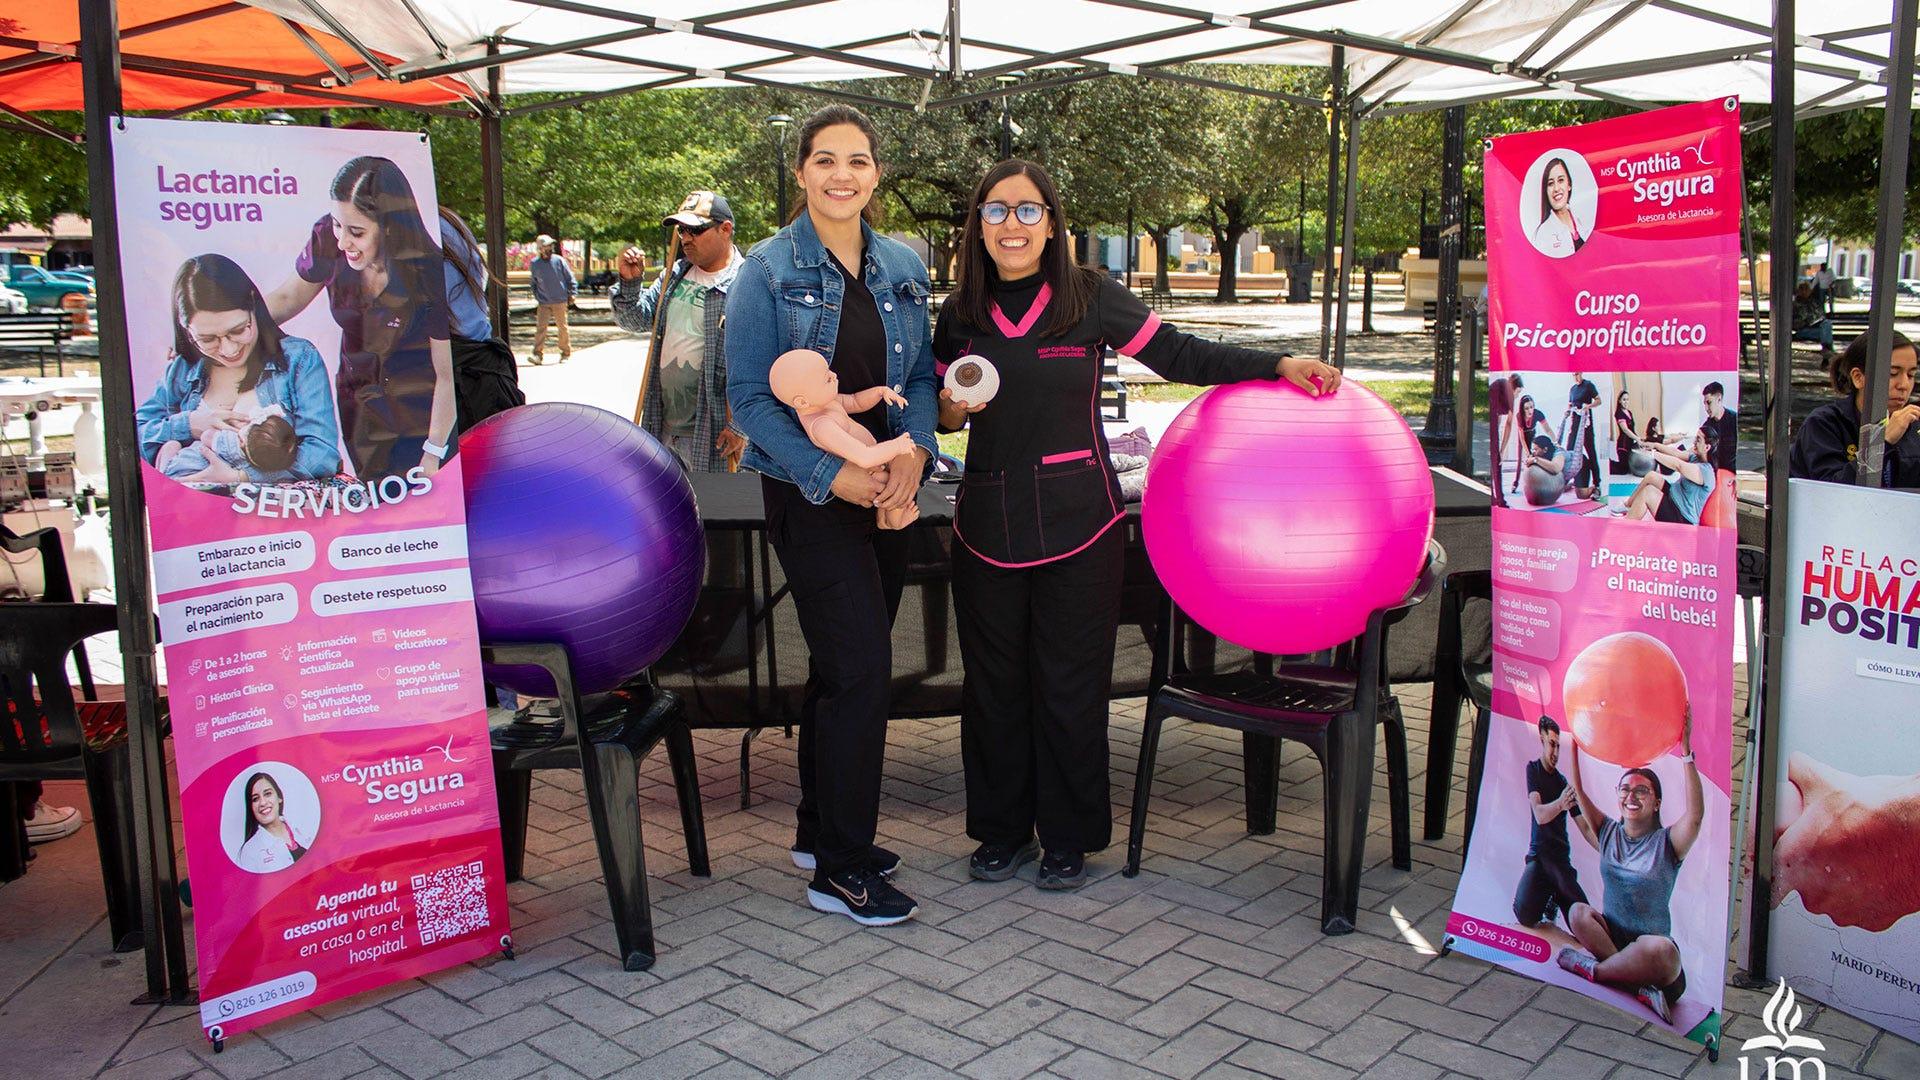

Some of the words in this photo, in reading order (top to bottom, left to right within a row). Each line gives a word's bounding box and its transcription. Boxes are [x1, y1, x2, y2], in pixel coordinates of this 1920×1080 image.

[1600, 167, 1615, 177] MSP
[1616, 151, 1682, 182] Cynthia
[157, 165, 298, 195] Lactancia
[1633, 174, 1714, 207] Segura
[160, 200, 263, 230] segura
[1637, 212, 1666, 223] Asesora
[1667, 211, 1677, 220] de
[1678, 206, 1714, 219] Lactancia
[1575, 290, 1640, 316] Curso
[1503, 318, 1707, 355] Psicoprofiláctico
[231, 465, 433, 519] SERVICIOS
[198, 546, 256, 562] Embarazo
[258, 545, 267, 553] e
[269, 539, 302, 552] inicio
[341, 546, 382, 558] Banco
[384, 543, 401, 554] de
[403, 540, 439, 552] leche
[1537, 548, 1568, 561] pareja
[1822, 545, 1918, 576] RELAC
[201, 567, 215, 578] de
[216, 564, 227, 575] la
[228, 557, 286, 573] lactancia
[1590, 548, 1678, 573] ¡Prepárate
[1681, 561, 1718, 579] para
[323, 591, 374, 605] Destete
[376, 584, 447, 599] respetuoso
[1607, 572, 1623, 591] el
[1627, 578, 1718, 603] nacimiento
[185, 596, 253, 617] Preparación
[255, 592, 285, 606] para
[1522, 602, 1547, 615] rebozo
[1642, 600, 1666, 619] del
[1670, 603, 1717, 628] bebé!
[186, 621, 198, 633] el
[200, 610, 264, 630] nacimiento
[1800, 594, 1920, 649] POSIT
[297, 635, 357, 651] Información
[394, 637, 448, 650] educativos
[204, 659, 218, 669] De
[219, 657, 225, 666] 1
[233, 653, 240, 663] 2
[240, 650, 268, 661] horas
[300, 659, 354, 675] actualizada
[394, 664, 426, 674] Grupo
[427, 661, 441, 670] de
[1867, 662, 1893, 674] CÓMO
[207, 671, 218, 682] de
[396, 675, 427, 687] apoyo
[429, 669, 461, 681] virtual
[301, 683, 364, 699] Seguimiento
[319, 694, 372, 708] WhatsApp
[397, 688, 420, 699] para
[421, 682, 459, 694] madres
[211, 706, 266, 726] Planificación
[303, 711, 330, 722] hasta
[331, 709, 341, 718] el
[343, 704, 380, 716] destete
[212, 717, 273, 741] personalizada
[320, 772, 341, 784] MSP
[342, 755, 424, 786] Cynthia
[366, 771, 465, 805] Segura
[373, 809, 410, 824] Asesora
[410, 805, 423, 816] de
[423, 799, 465, 814] Lactancia
[315, 882, 377, 912] Agenda
[379, 879, 399, 894] tu
[282, 910, 349, 941] asesoría
[350, 898, 401, 921] virtual,
[299, 941, 319, 958] en
[321, 933, 353, 952] casa
[355, 929, 366, 941] o
[368, 922, 389, 938] en
[390, 916, 405, 932] el
[1478, 928, 1497, 941] 826
[1499, 934, 1518, 948] 126
[1519, 940, 1542, 956] 1019
[348, 935, 408, 964] hospital.
[1830, 951, 1873, 975] MARIO
[235, 995, 257, 1010] 826
[258, 989, 278, 1004] 126
[279, 981, 306, 998] 1019
